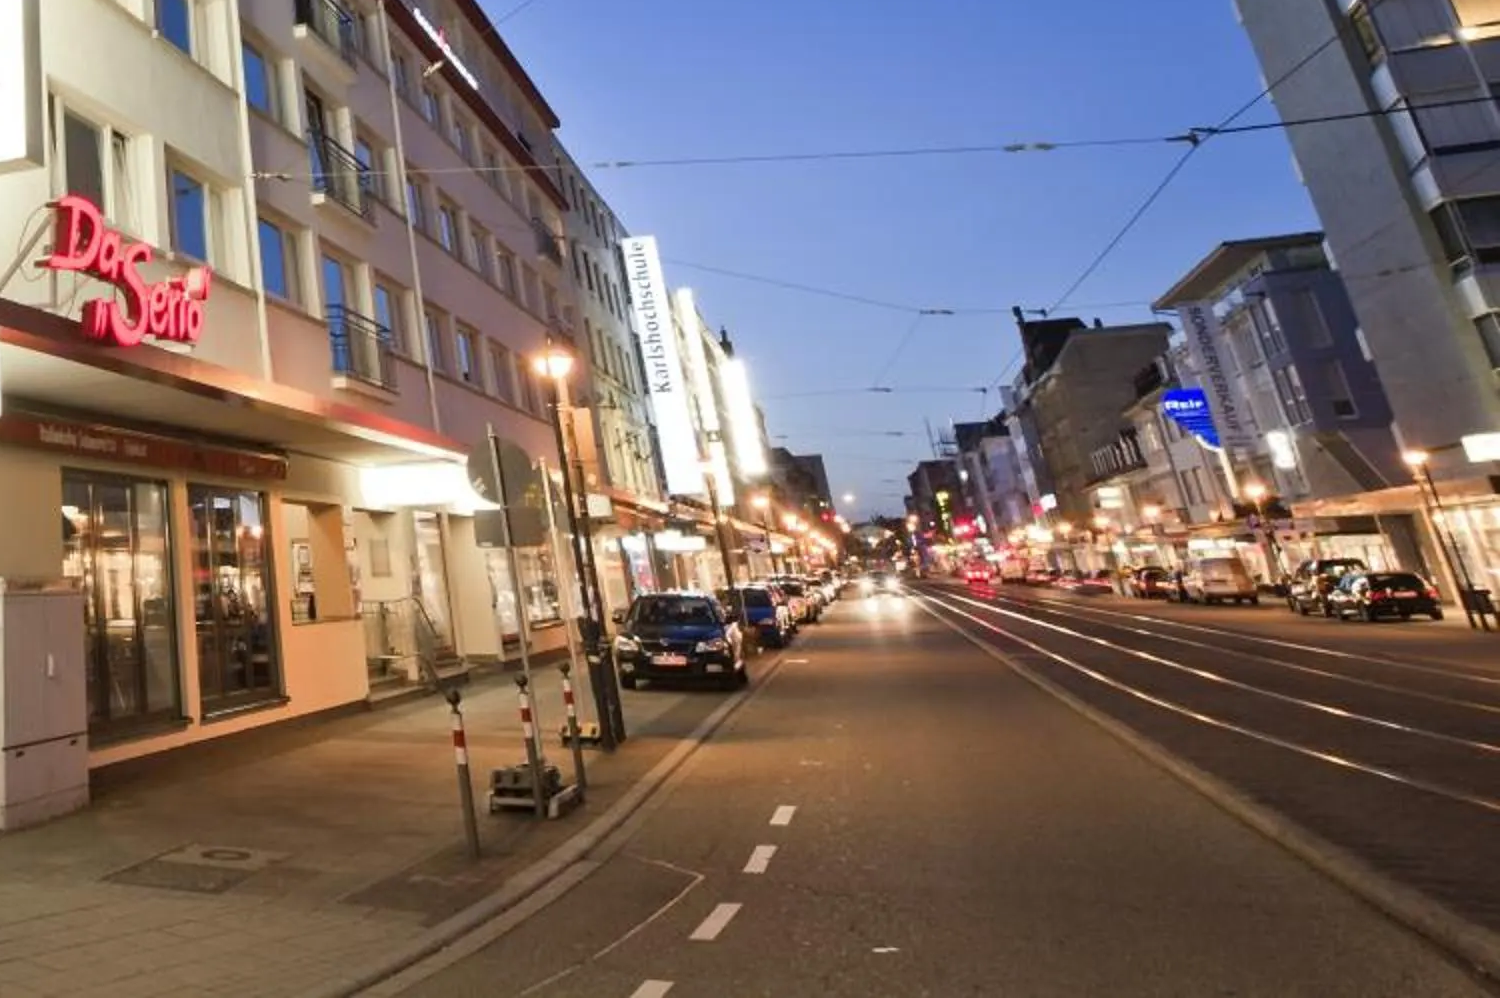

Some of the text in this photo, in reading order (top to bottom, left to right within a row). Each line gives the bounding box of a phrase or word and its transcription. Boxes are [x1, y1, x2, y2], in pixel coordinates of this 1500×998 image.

[35, 193, 120, 279] Da
[628, 240, 672, 394] Karlshochschule
[1188, 306, 1239, 432] SONDERVERKAUF
